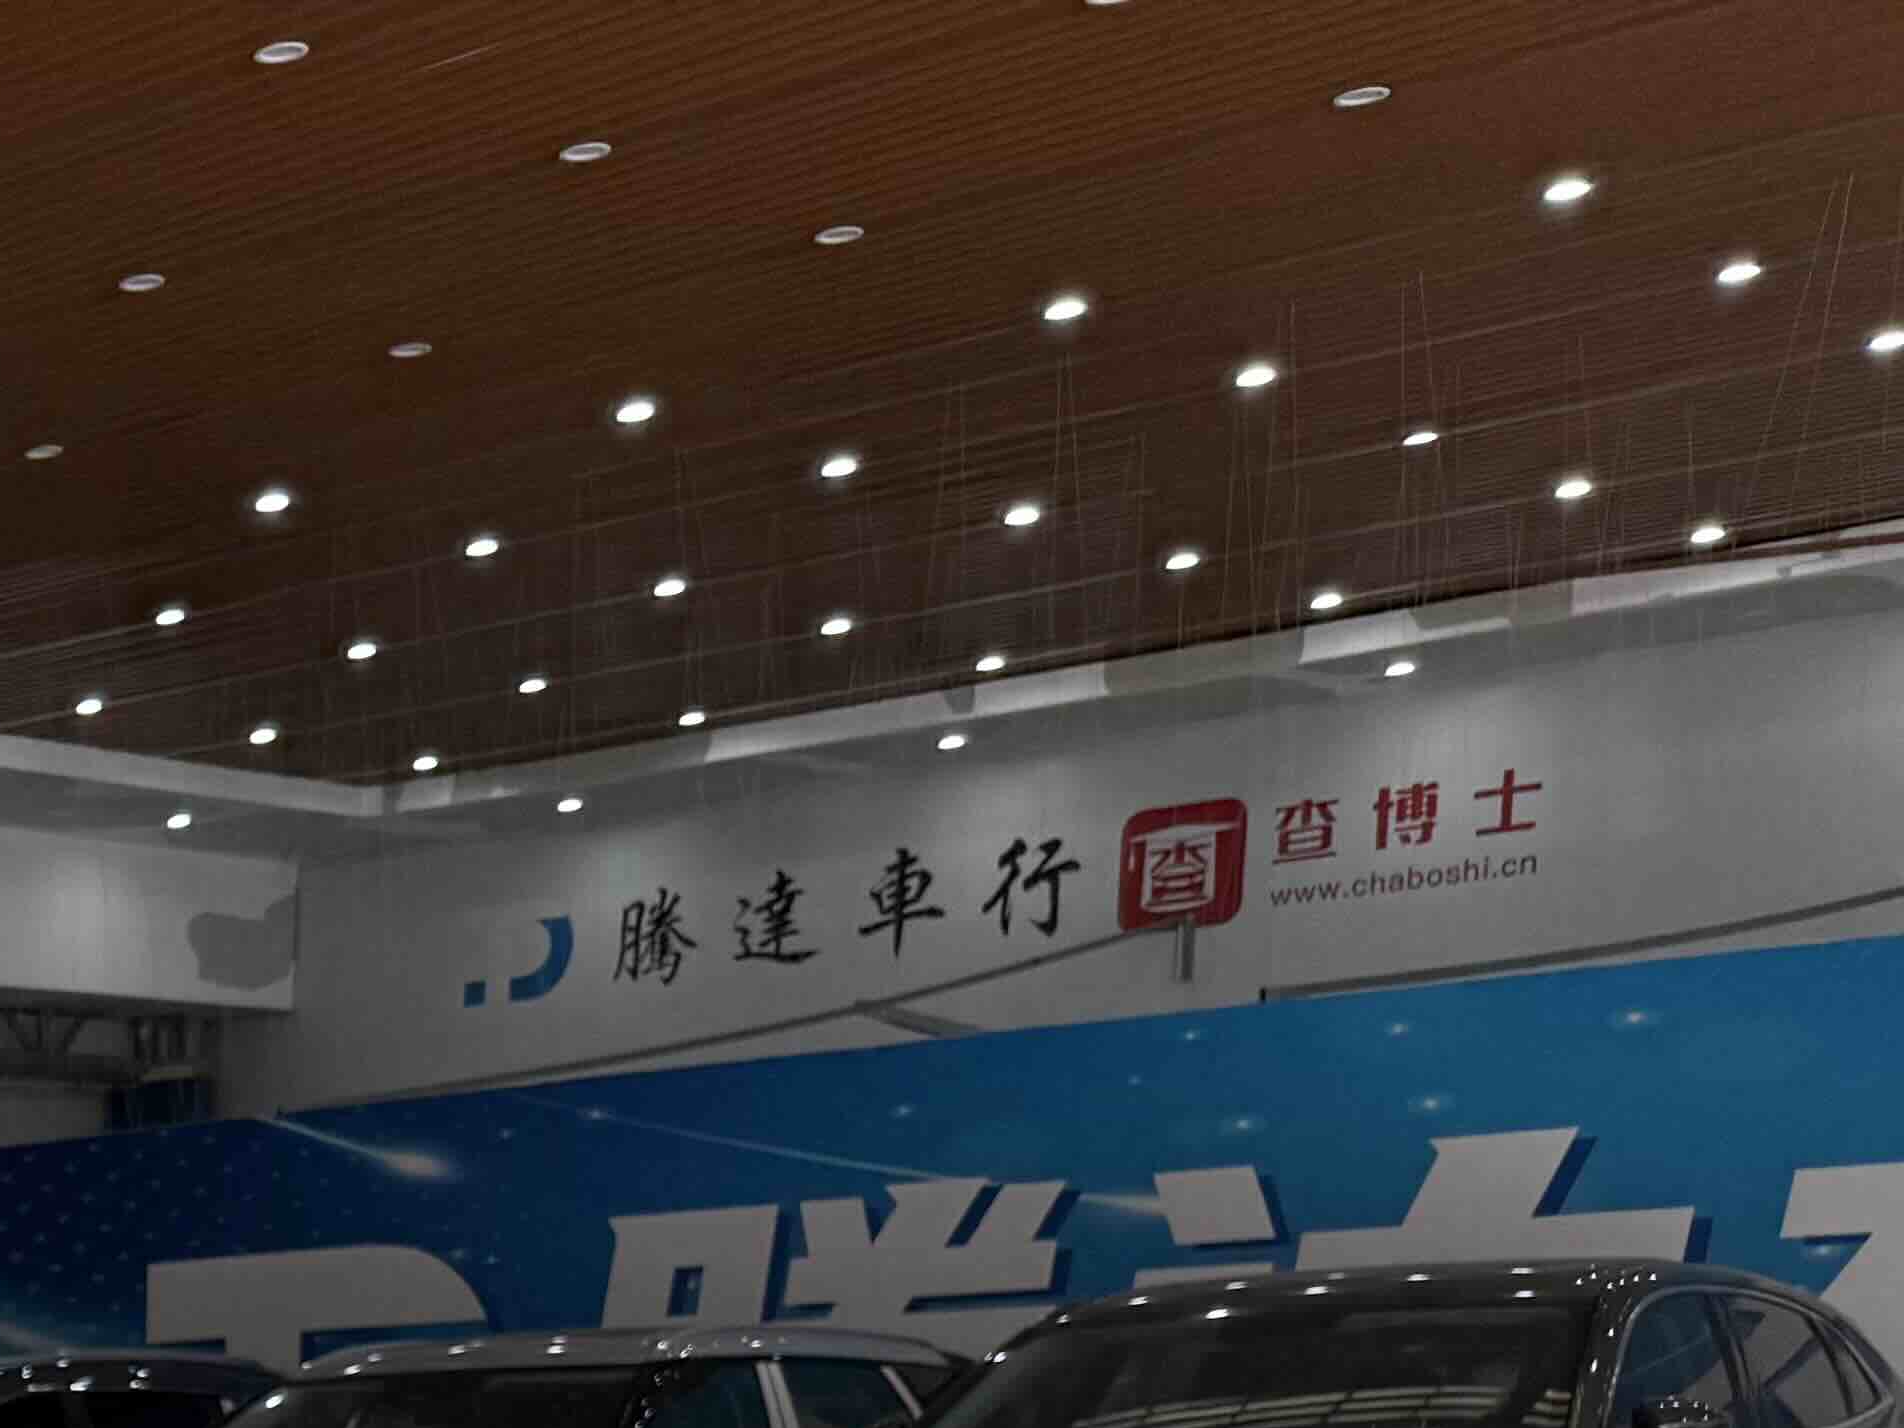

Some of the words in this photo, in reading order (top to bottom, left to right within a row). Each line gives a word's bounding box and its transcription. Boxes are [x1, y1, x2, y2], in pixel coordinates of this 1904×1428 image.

[1272, 768, 1544, 865] 查博士
[1270, 852, 1539, 907] www.chaboshi.cn
